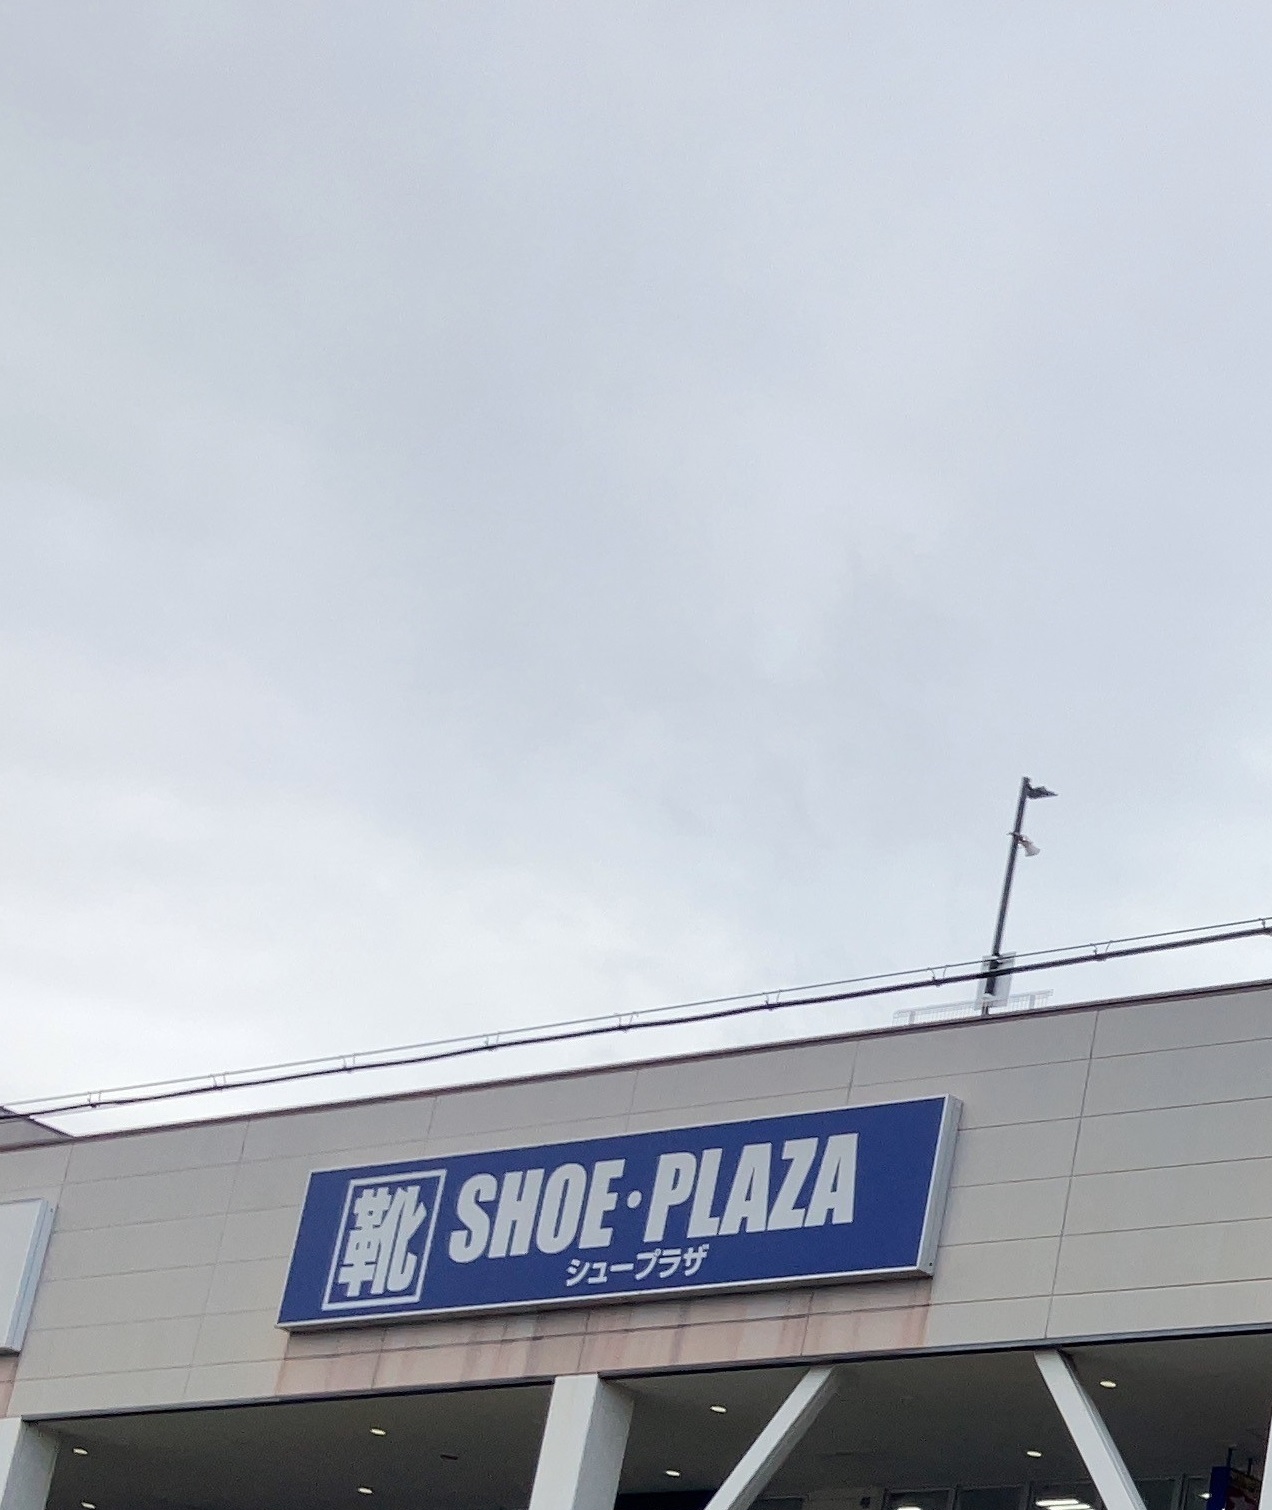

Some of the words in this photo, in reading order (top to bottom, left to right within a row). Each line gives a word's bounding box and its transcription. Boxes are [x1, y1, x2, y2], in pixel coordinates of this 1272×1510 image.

[337, 1185, 428, 1299] 靴
[566, 1242, 710, 1288] シュープラザ
